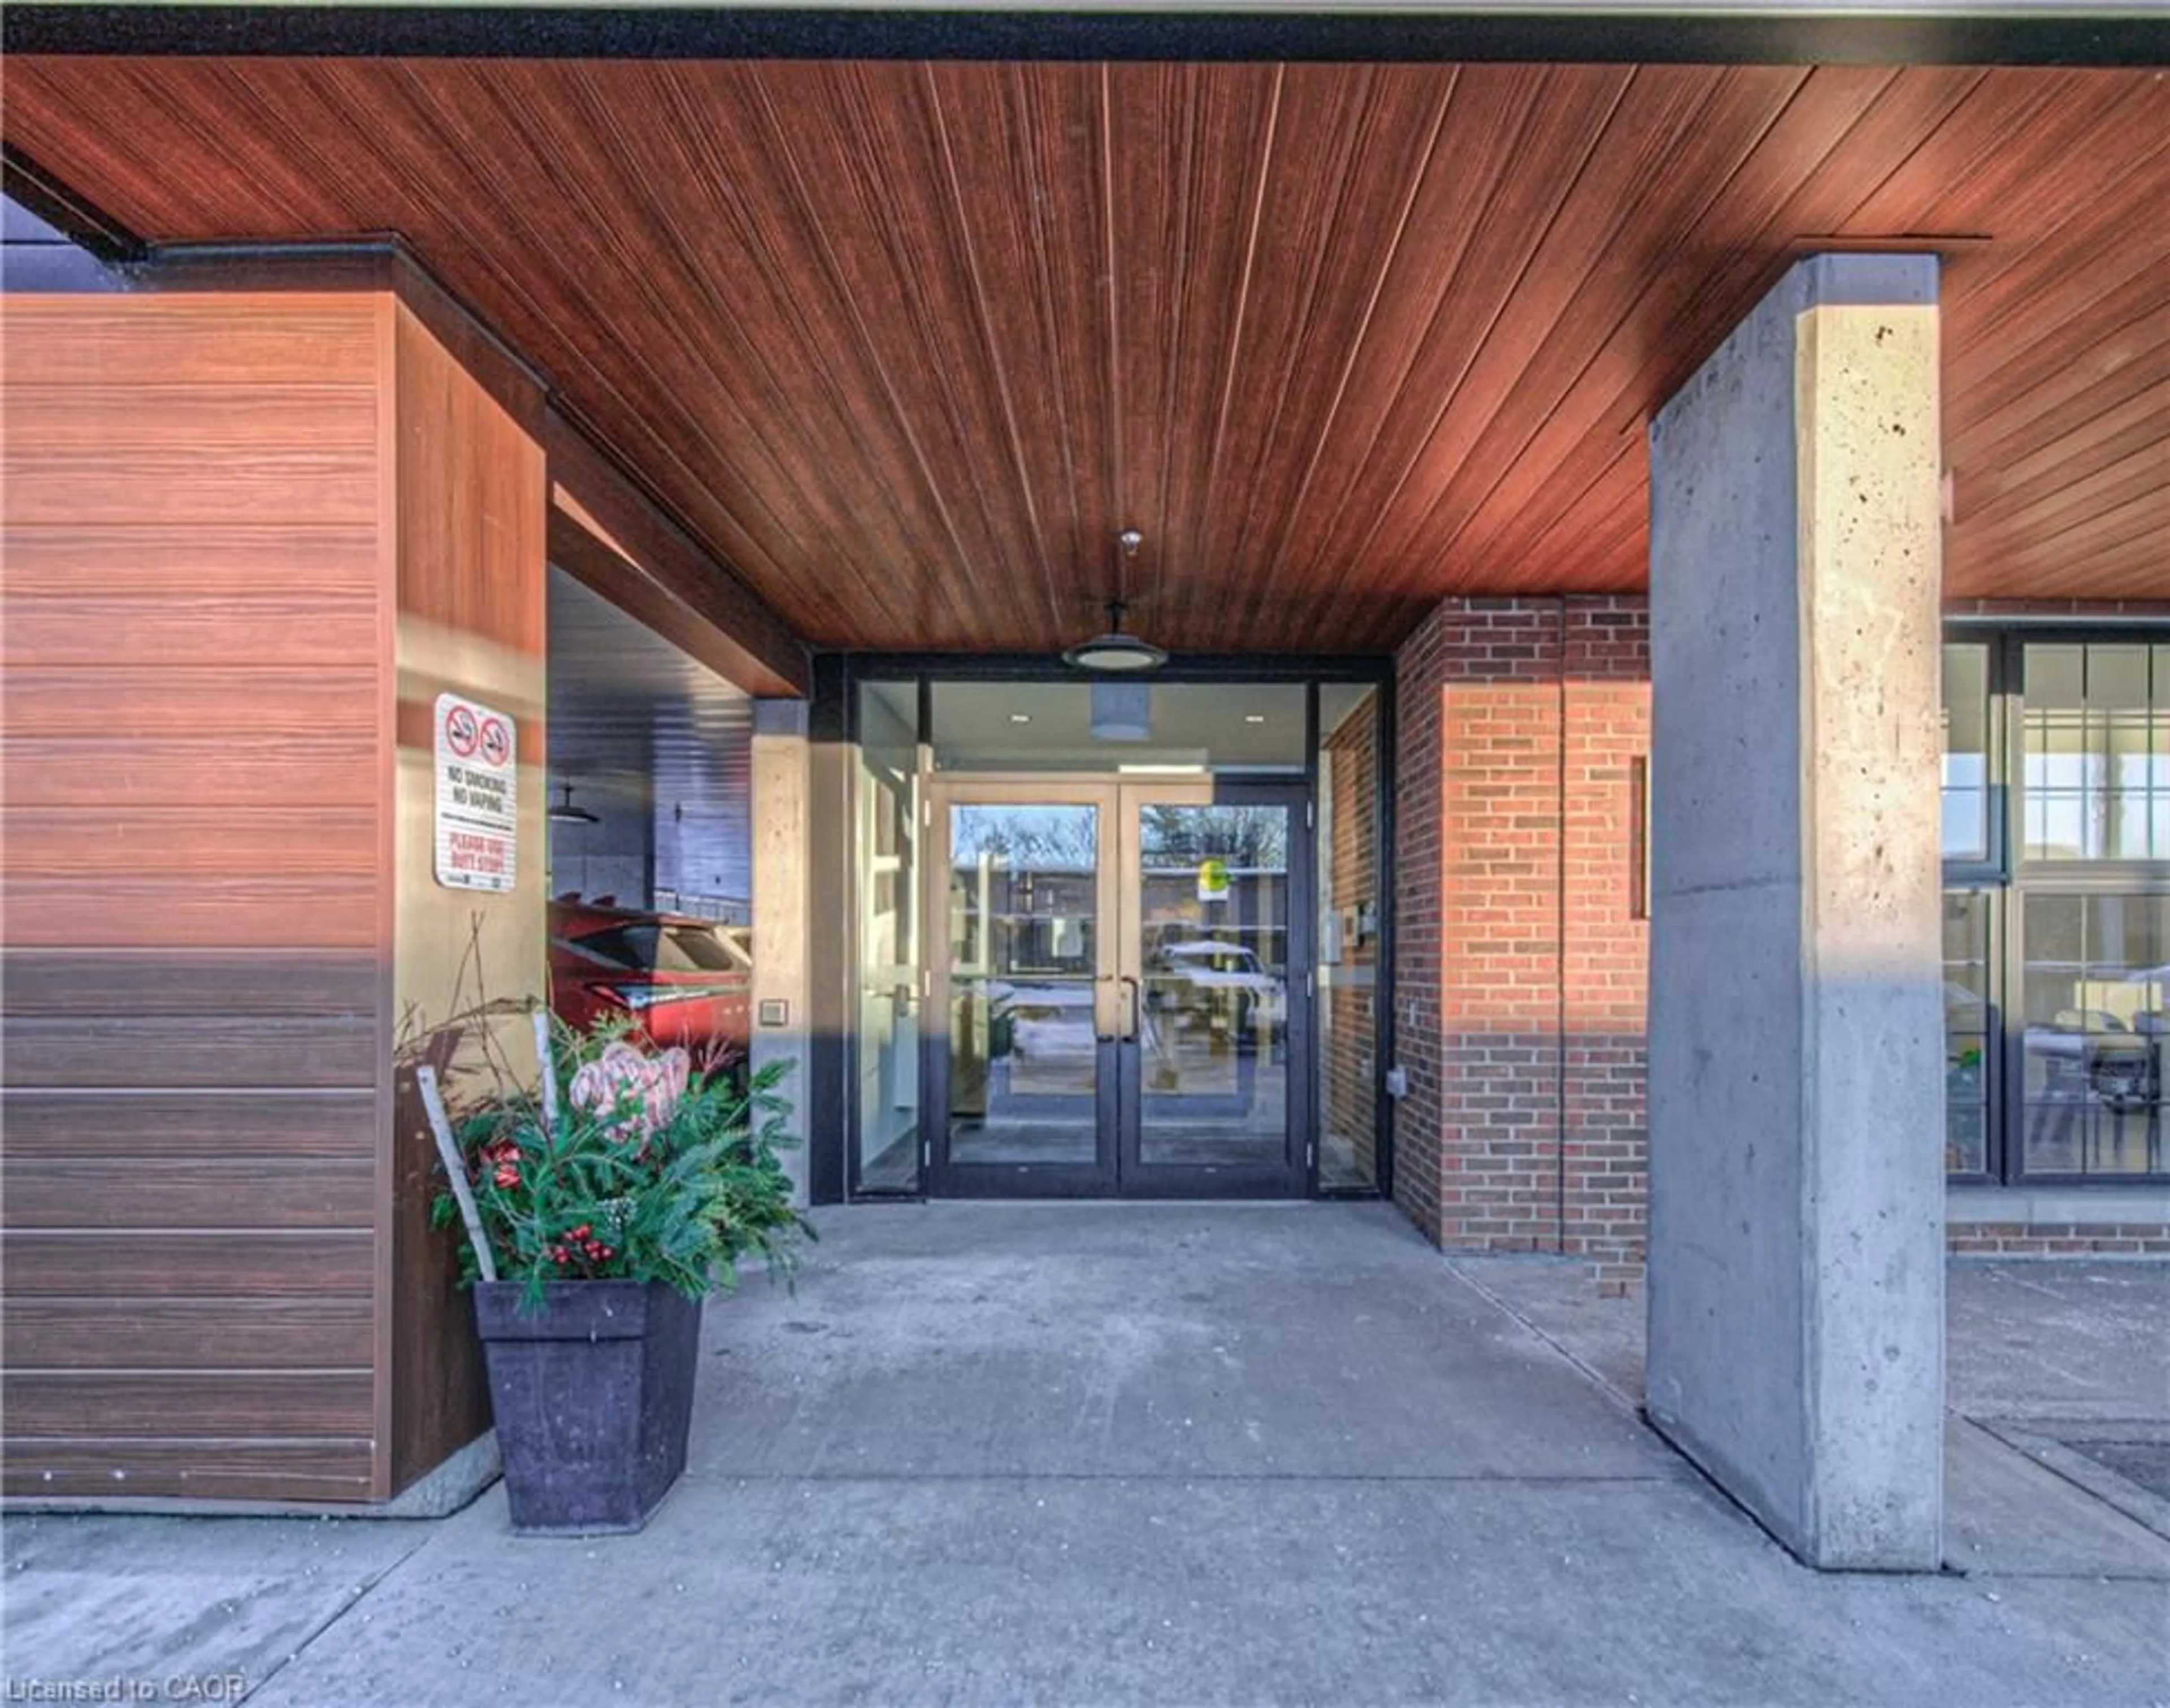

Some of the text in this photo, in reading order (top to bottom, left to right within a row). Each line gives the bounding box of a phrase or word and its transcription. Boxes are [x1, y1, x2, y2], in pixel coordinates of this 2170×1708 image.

[448, 765, 506, 794] NO SMOKING
[453, 786, 502, 812] NO VAPING
